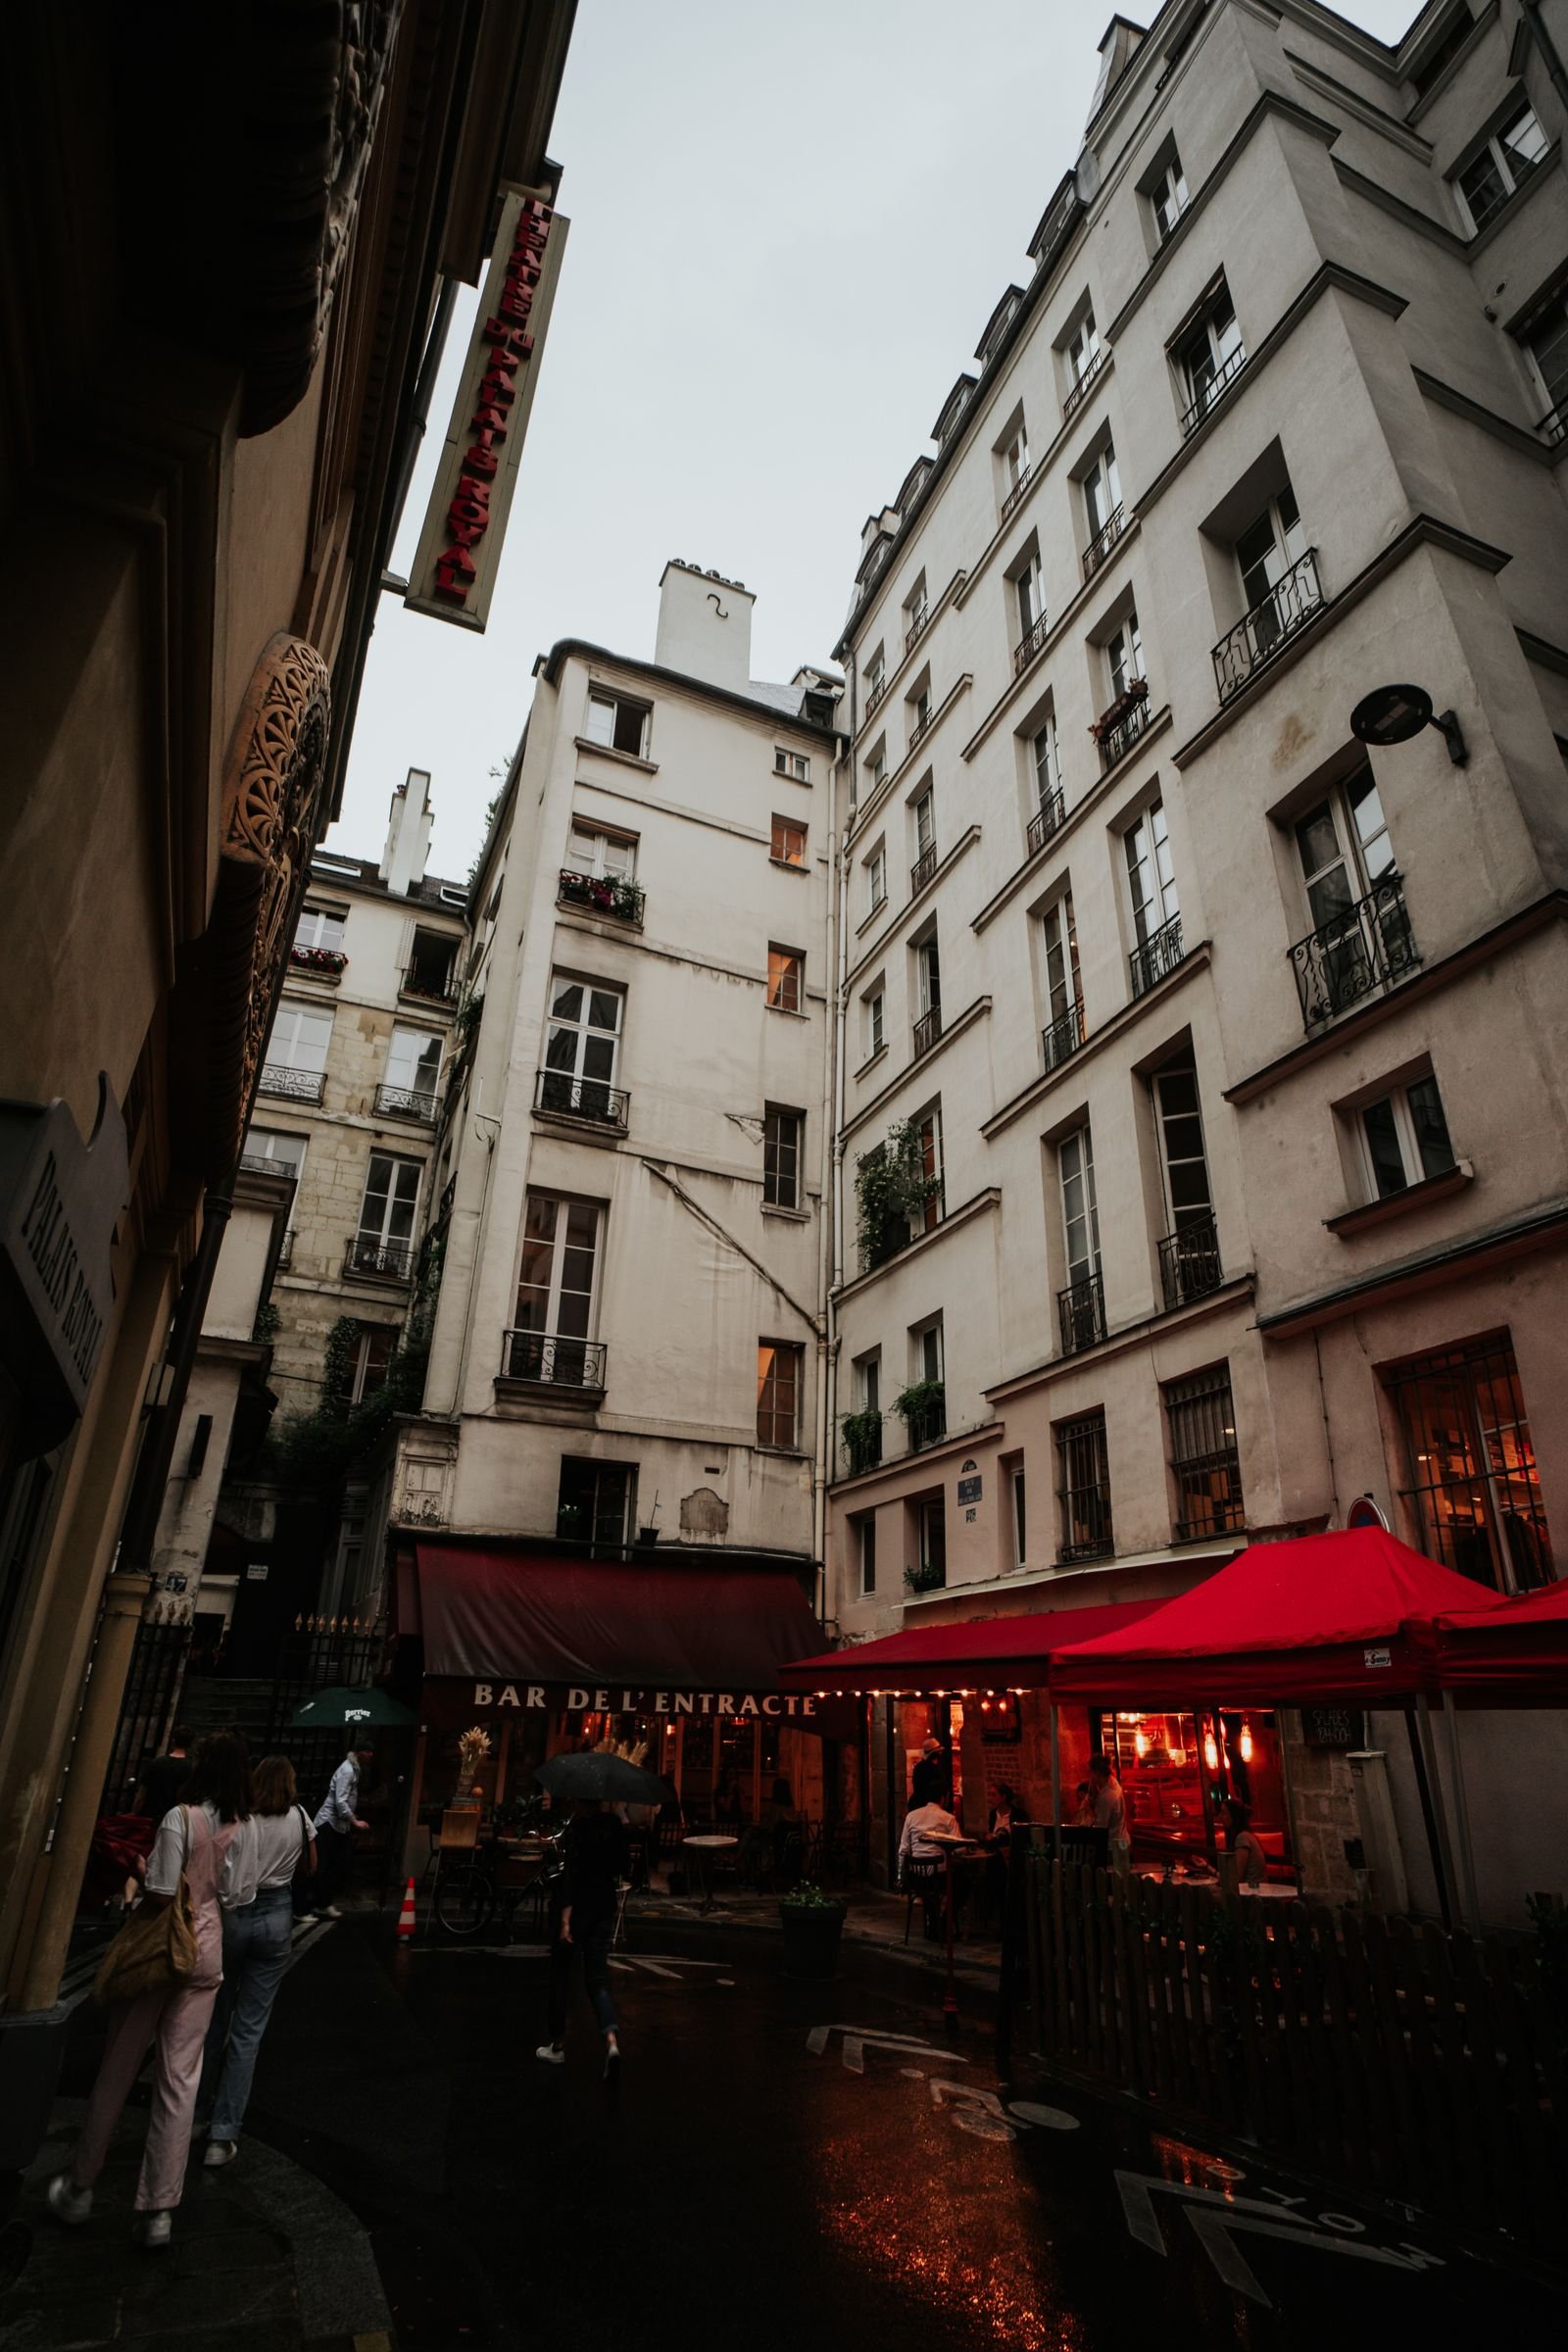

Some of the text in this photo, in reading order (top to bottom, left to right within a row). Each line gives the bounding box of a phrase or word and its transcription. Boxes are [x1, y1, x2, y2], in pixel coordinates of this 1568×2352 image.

[500, 195, 553, 323] THEATRE
[462, 345, 519, 481] PALAIS
[434, 475, 491, 607] ROYAL
[22, 1150, 103, 1387] PALAIS ROYAL
[166, 1577, 186, 1592] 47
[473, 1683, 546, 1709] BAR
[566, 1688, 611, 1712] DE
